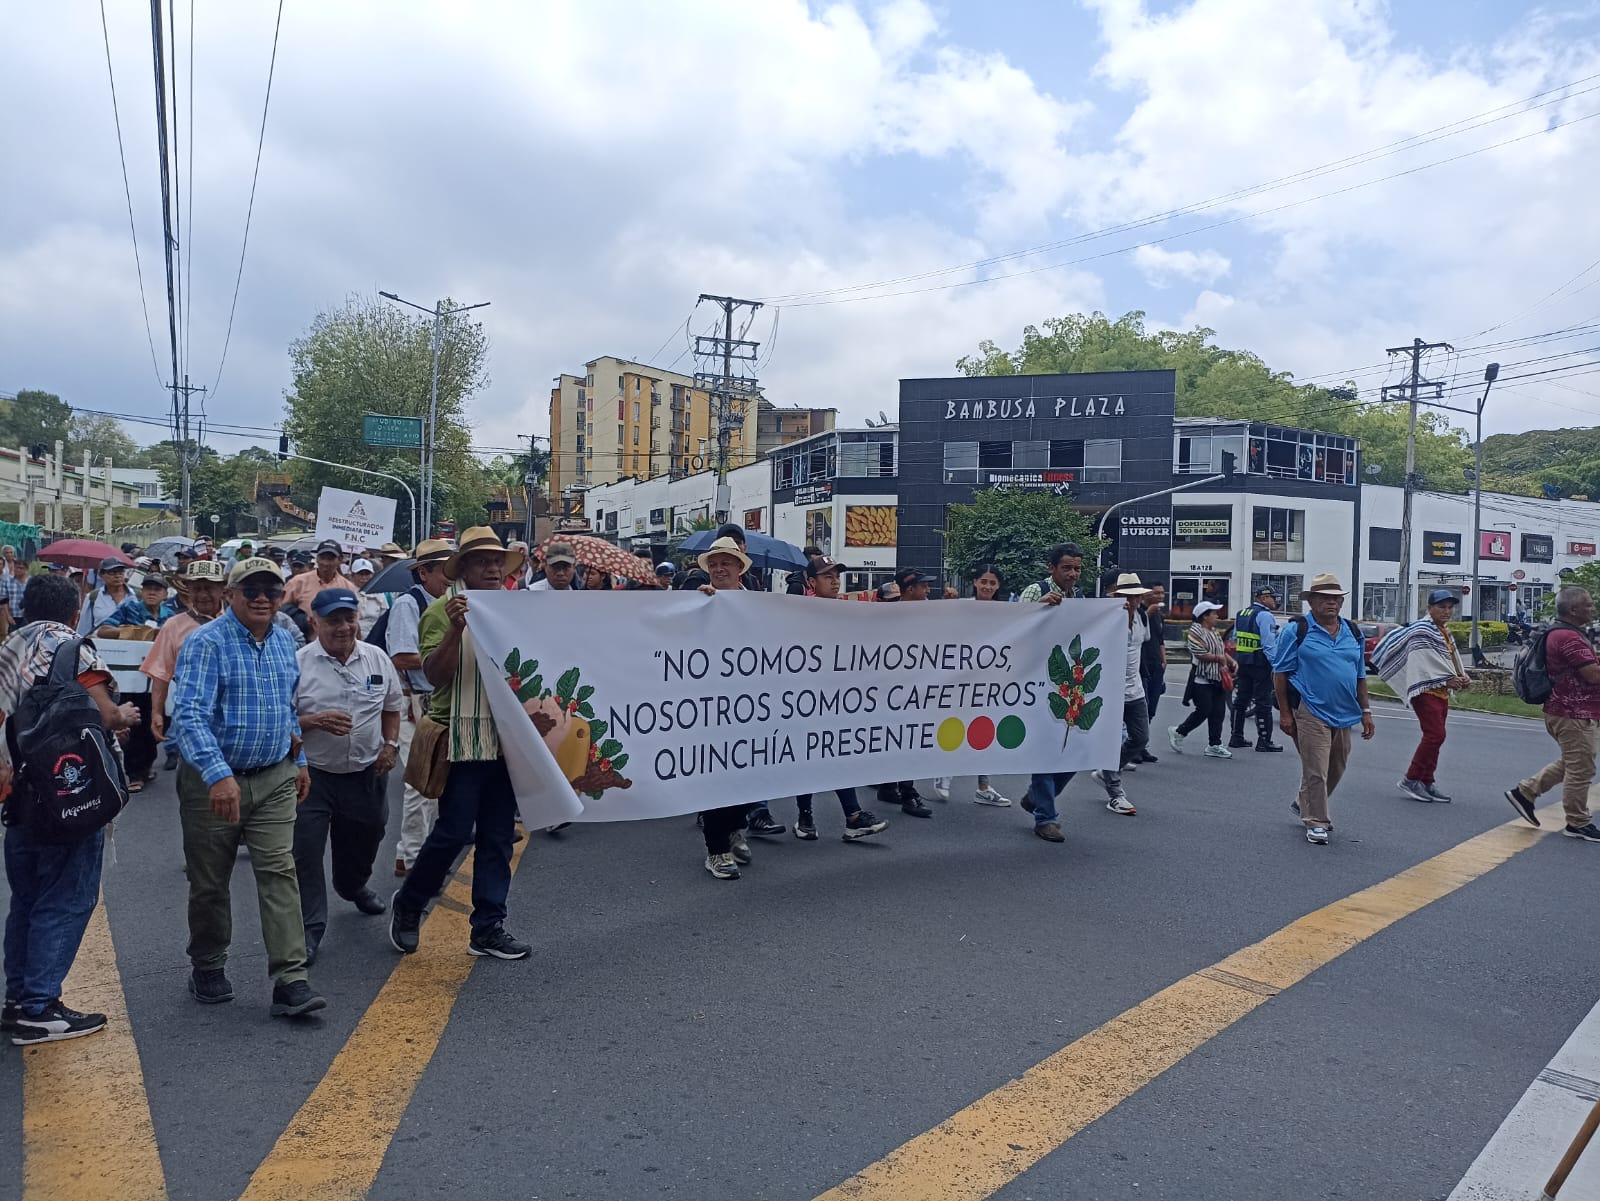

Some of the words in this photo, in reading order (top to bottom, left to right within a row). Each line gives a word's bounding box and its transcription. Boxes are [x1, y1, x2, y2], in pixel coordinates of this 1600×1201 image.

[944, 399, 1036, 420] BAMBUSA
[1054, 396, 1126, 417] PLAZA
[332, 524, 362, 534] INMEDIATA
[1120, 516, 1171, 525] CARBON
[1121, 527, 1170, 536] BURGER
[720, 644, 823, 678] SOMOS
[833, 643, 1012, 673] LIMOSNEROS,
[609, 691, 771, 739] NOSOTROS
[780, 686, 879, 720] SOMOS
[654, 728, 796, 781] QUINCHÍA
[806, 722, 935, 761] PRESENTE
